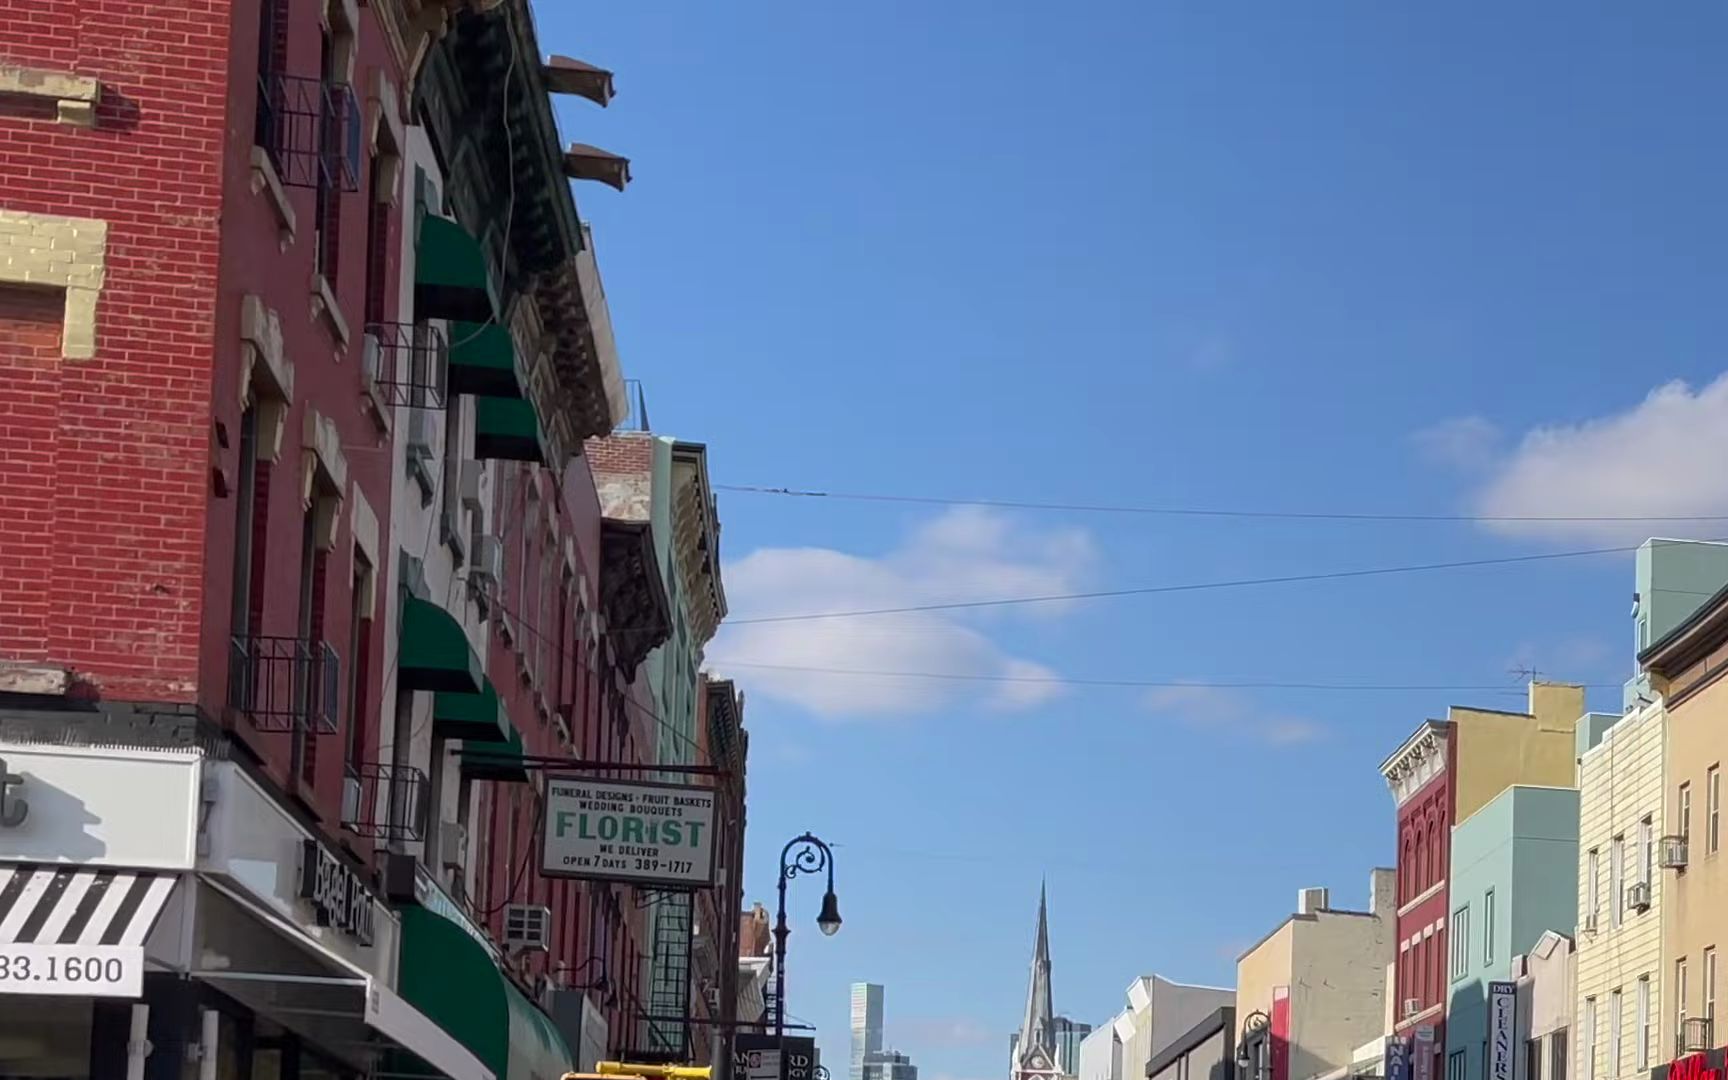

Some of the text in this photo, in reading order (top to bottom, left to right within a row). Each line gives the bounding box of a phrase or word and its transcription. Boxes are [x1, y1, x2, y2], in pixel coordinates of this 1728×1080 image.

[551, 786, 713, 809] FUNERAL DESIGNS FRUIT BASKETS
[579, 800, 683, 817] WEDDING BOUQUETS
[555, 810, 705, 848] FLORIST
[599, 844, 660, 858] WE DELIVER
[562, 855, 693, 874] OPEN 7 DAYS 389-1717
[1492, 984, 1515, 995] DRY
